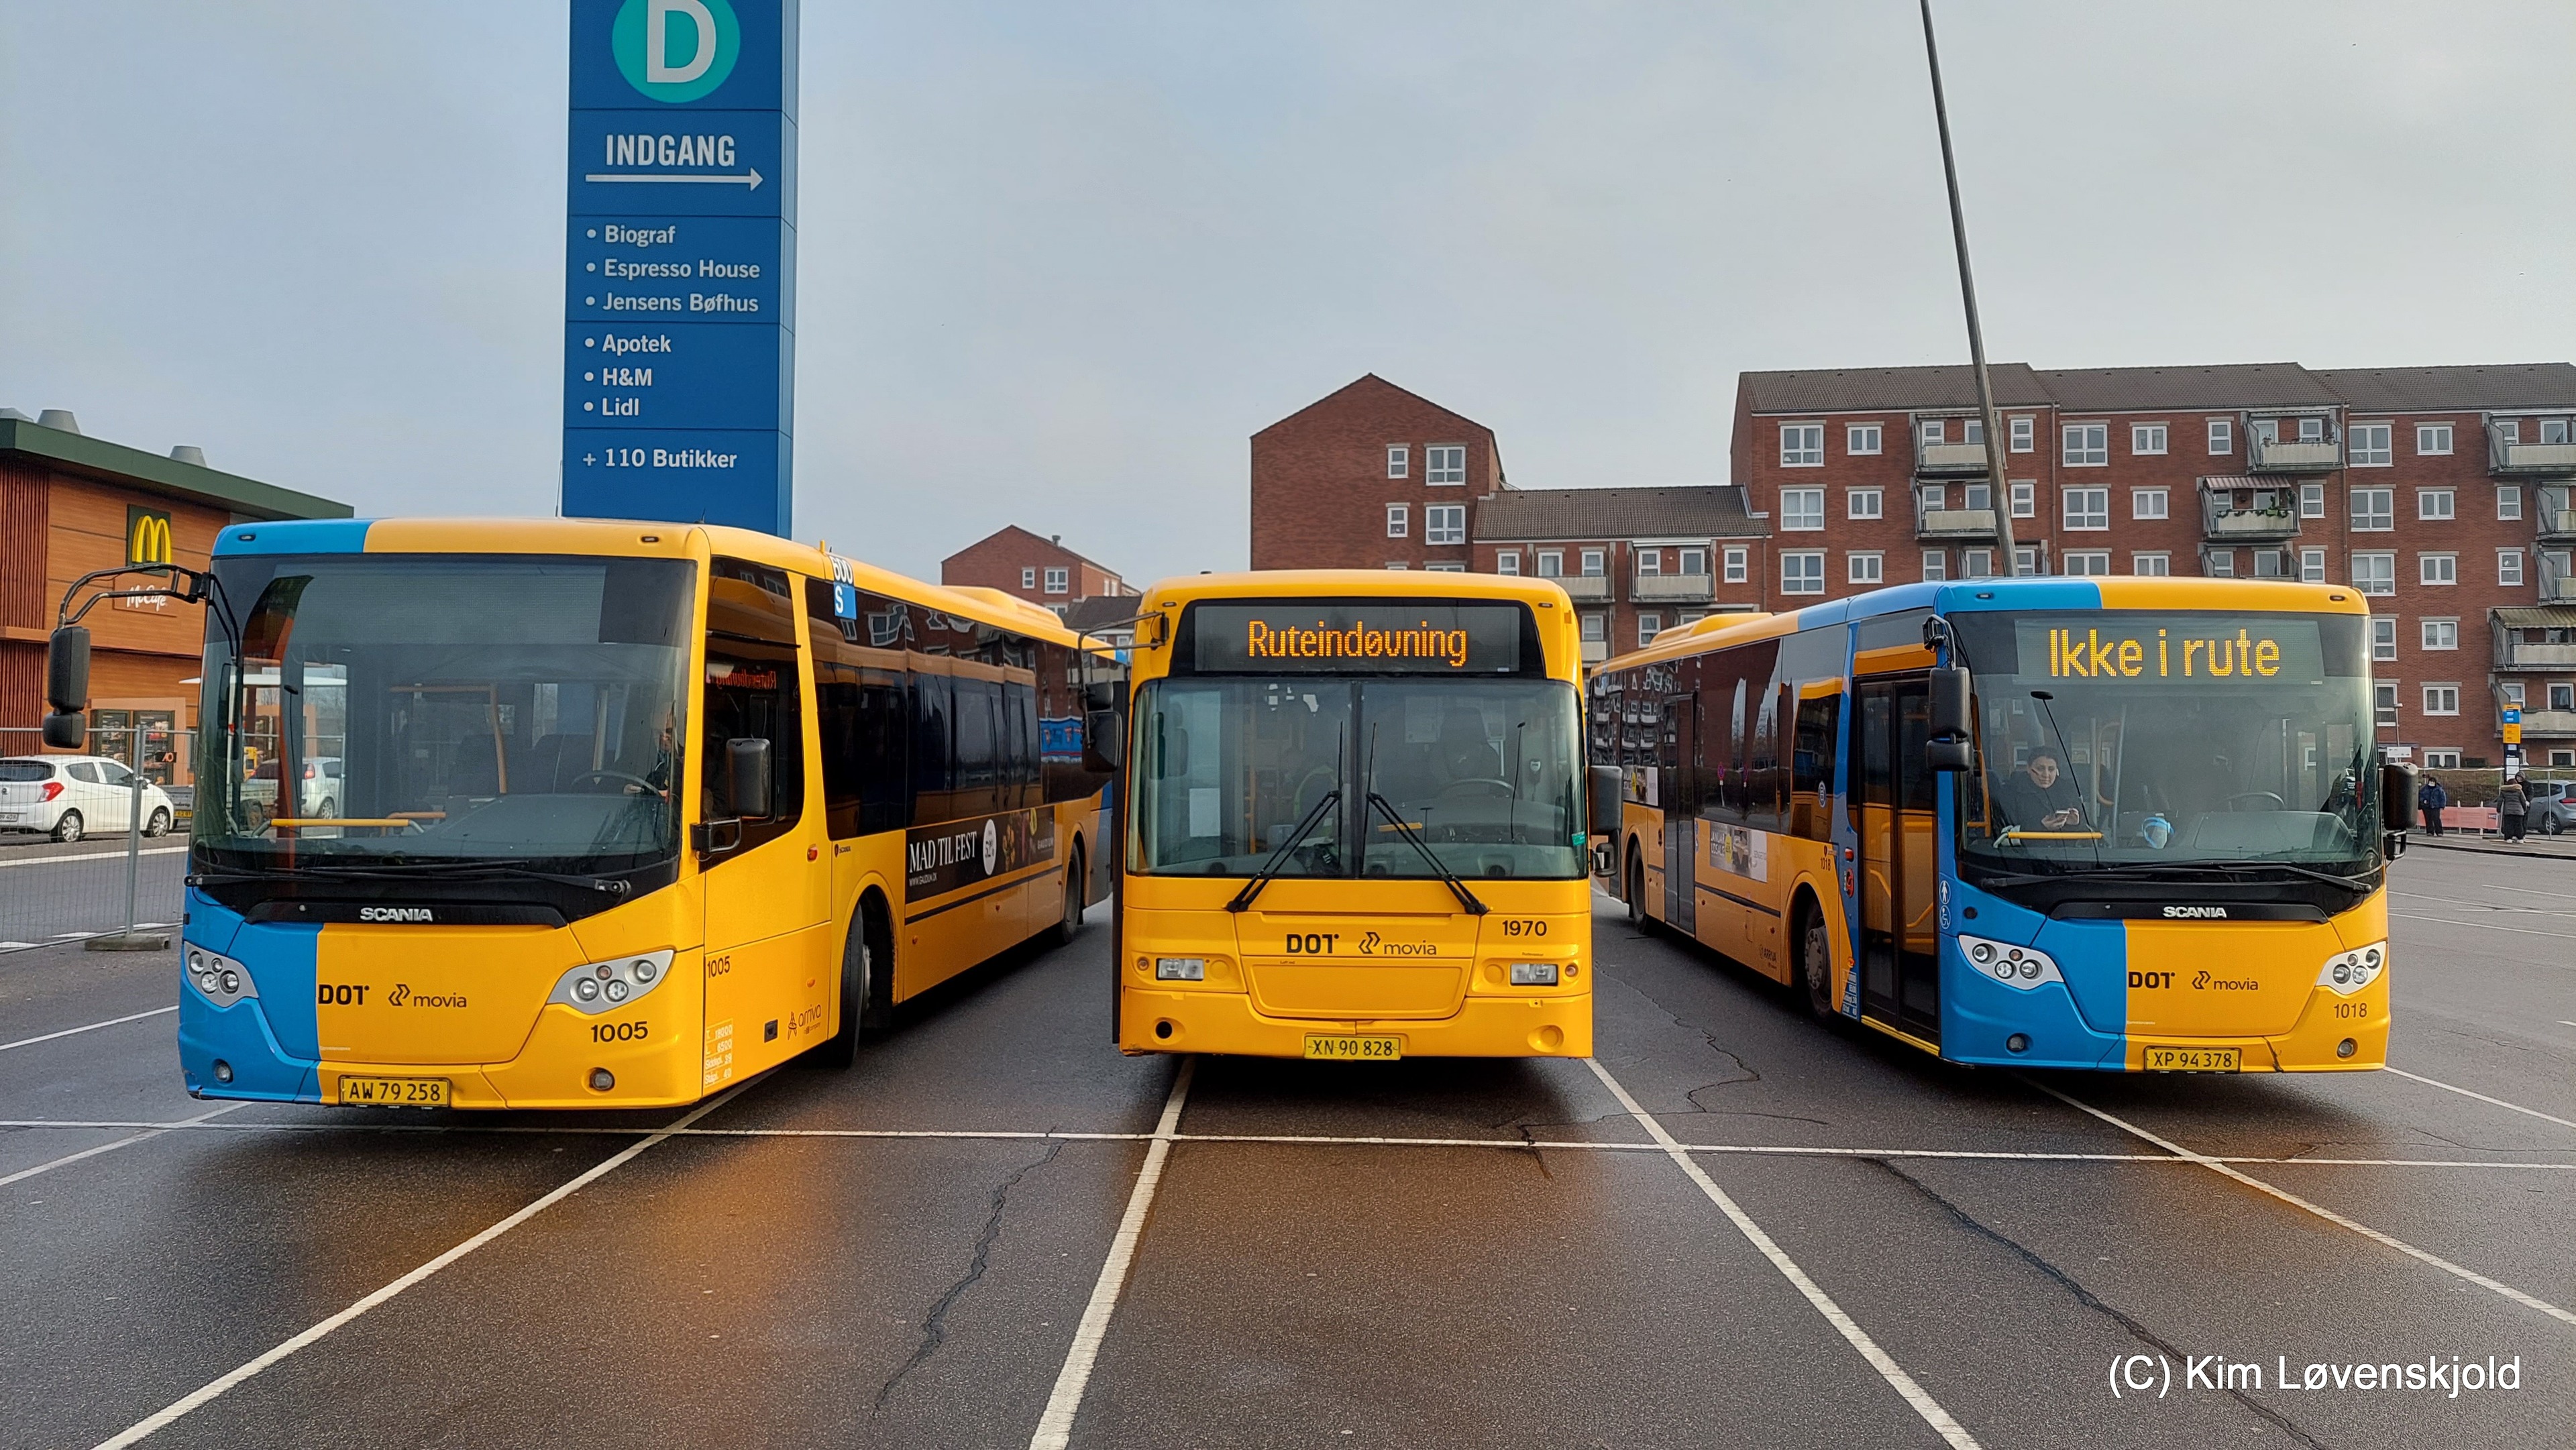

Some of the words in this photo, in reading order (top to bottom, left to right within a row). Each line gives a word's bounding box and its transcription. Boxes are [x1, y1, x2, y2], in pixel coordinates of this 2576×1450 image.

[647, 0, 716, 83] D
[606, 135, 735, 166] INDGANG
[605, 225, 676, 247] Biograf
[604, 259, 692, 282] Espresso
[699, 260, 760, 279] House
[603, 292, 682, 311] Jensens
[690, 293, 759, 313] Bøfhus
[602, 335, 671, 357] Apotek
[602, 368, 652, 387] H&M
[602, 398, 639, 416] Lidl
[605, 449, 645, 468] 110
[653, 449, 737, 469] Butikker
[830, 555, 853, 584] 600
[835, 585, 843, 614] S
[1248, 620, 1467, 667] Ruteindøvning
[2049, 629, 2143, 677] Ikke
[2158, 629, 2167, 677] i
[2184, 629, 2279, 677] rute
[909, 840, 936, 873] MAD
[938, 837, 954, 867] TIL
[955, 831, 977, 862] FEST
[1820, 857, 1831, 871] 1018
[360, 907, 433, 922] SCANIA
[2163, 906, 2227, 918] SCANIA
[1502, 920, 1548, 936] 1970
[1286, 934, 1340, 954] DOT
[1384, 940, 1437, 955] movia
[707, 956, 730, 979] 1005
[2128, 971, 2176, 989] DOT
[2214, 977, 2259, 991] movia
[317, 984, 370, 1005] DOT
[413, 992, 467, 1008] movia
[798, 1004, 822, 1027] arriva
[2333, 1003, 2367, 1019] 1018
[590, 1021, 649, 1043] 1005
[1312, 1040, 1334, 1055] XN
[1339, 1040, 1358, 1056] 90
[1363, 1041, 1393, 1056] 828
[2153, 1052, 2174, 1066] XP
[2180, 1052, 2200, 1067] 94
[2204, 1052, 2233, 1068] 378
[349, 1082, 374, 1100] AW
[378, 1082, 401, 1101] 79
[407, 1082, 441, 1101] 258
